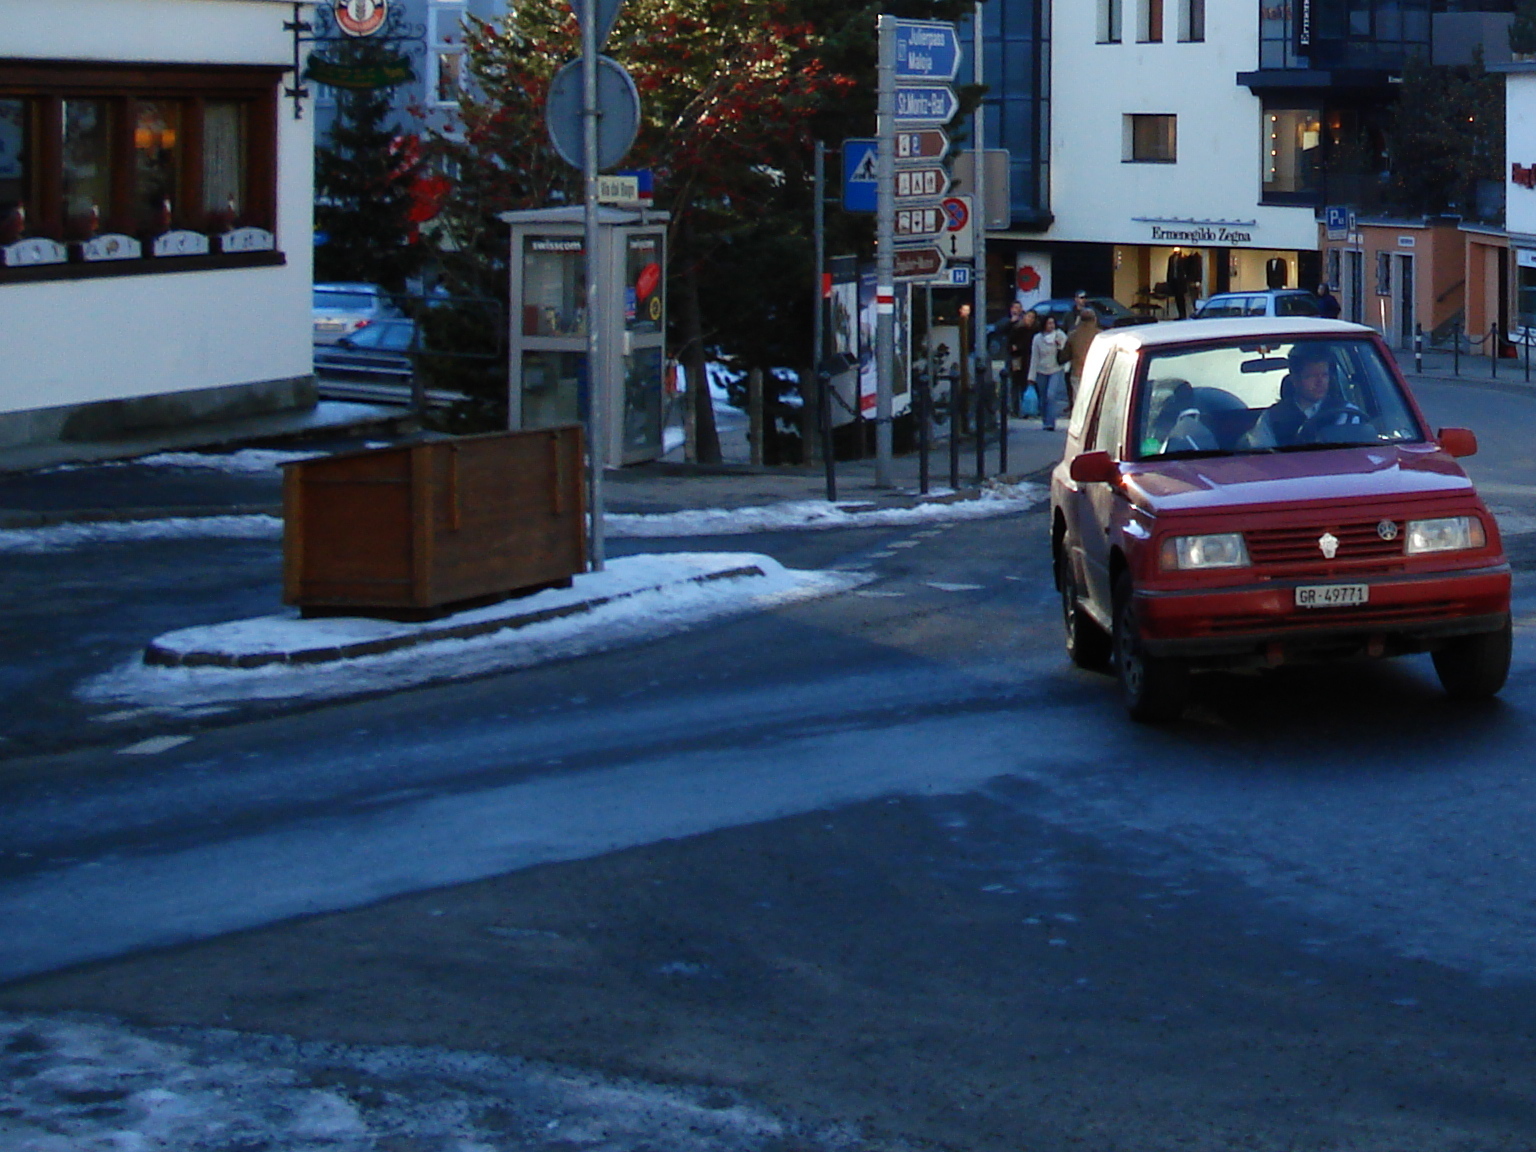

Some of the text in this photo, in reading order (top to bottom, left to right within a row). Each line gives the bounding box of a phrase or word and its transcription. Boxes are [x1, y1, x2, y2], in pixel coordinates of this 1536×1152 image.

[908, 28, 945, 50] Julierpass
[908, 52, 932, 74] Maloja
[1330, 209, 1339, 225] P
[1152, 227, 1251, 243] Ermenegildo Zegna
[532, 239, 582, 250] swisscom
[955, 271, 964, 281] H
